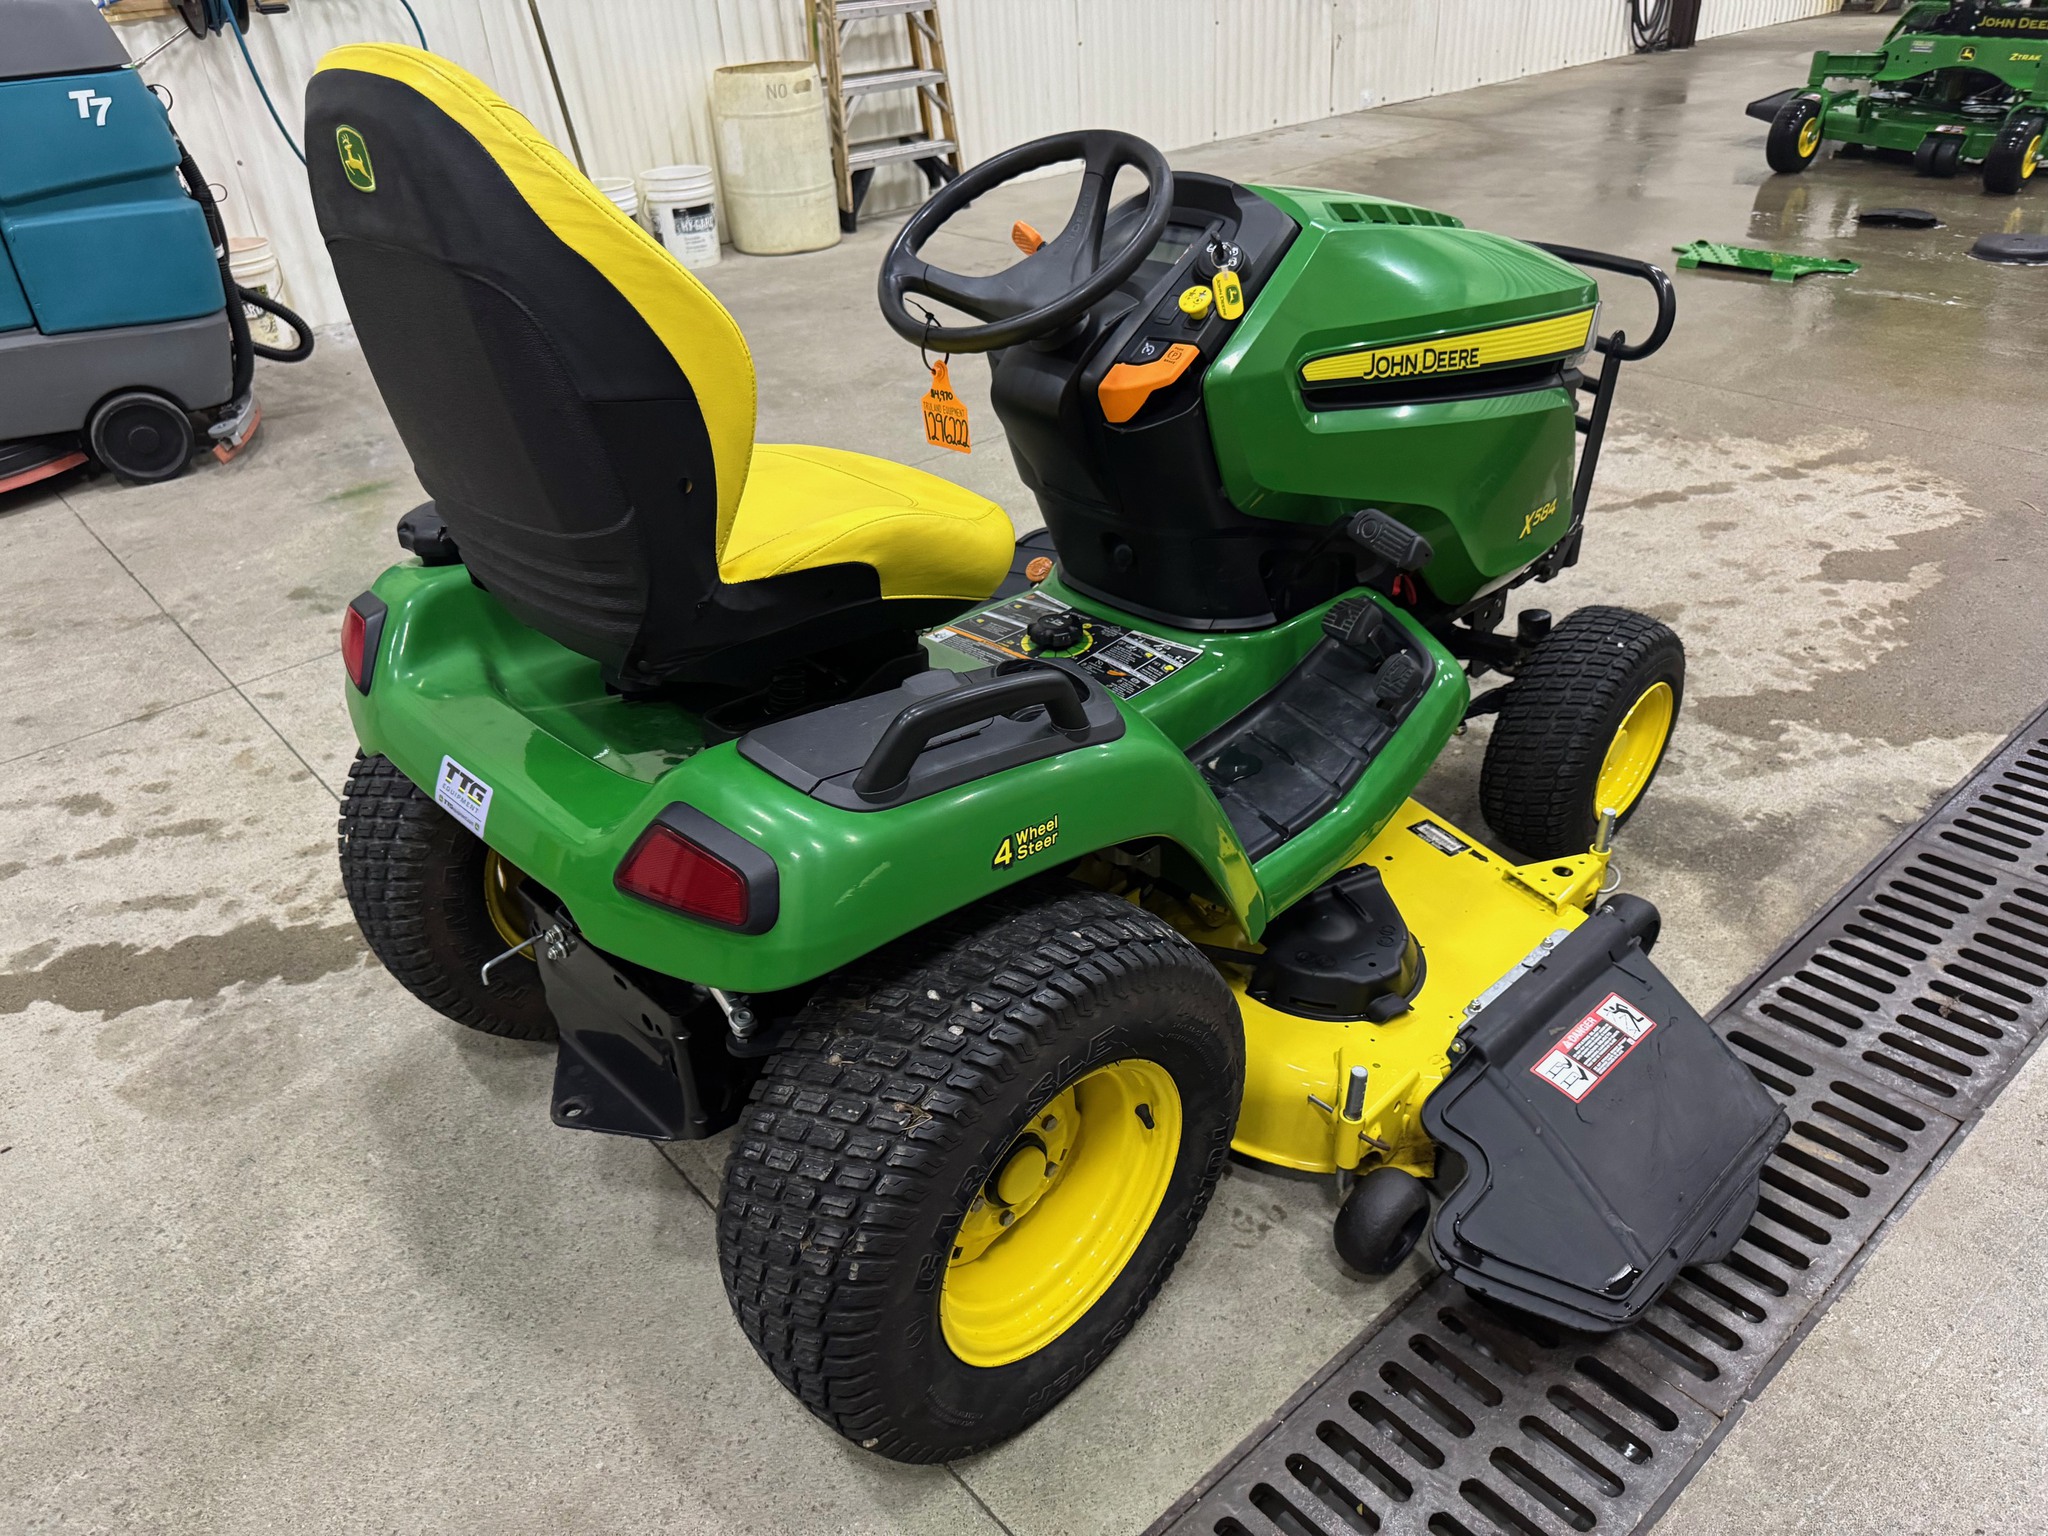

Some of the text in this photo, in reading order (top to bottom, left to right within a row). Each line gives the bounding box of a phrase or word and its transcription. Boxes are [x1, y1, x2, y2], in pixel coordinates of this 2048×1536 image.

[1977, 15, 2048, 30] JOHN DEE
[2009, 52, 2043, 62] ZTRAK
[68, 89, 112, 126] T7
[766, 83, 788, 100] NO
[1363, 347, 1480, 379] JOHN DEERE
[924, 410, 970, 448] 1296222
[1518, 497, 1557, 540] X584
[442, 782, 479, 814] EQUIPMENT
[444, 761, 488, 807] TTG
[1015, 814, 1058, 846] Wheel
[1016, 831, 1059, 860] Steer
[993, 837, 1014, 867] 4
[1569, 1016, 1598, 1046] DANGER
